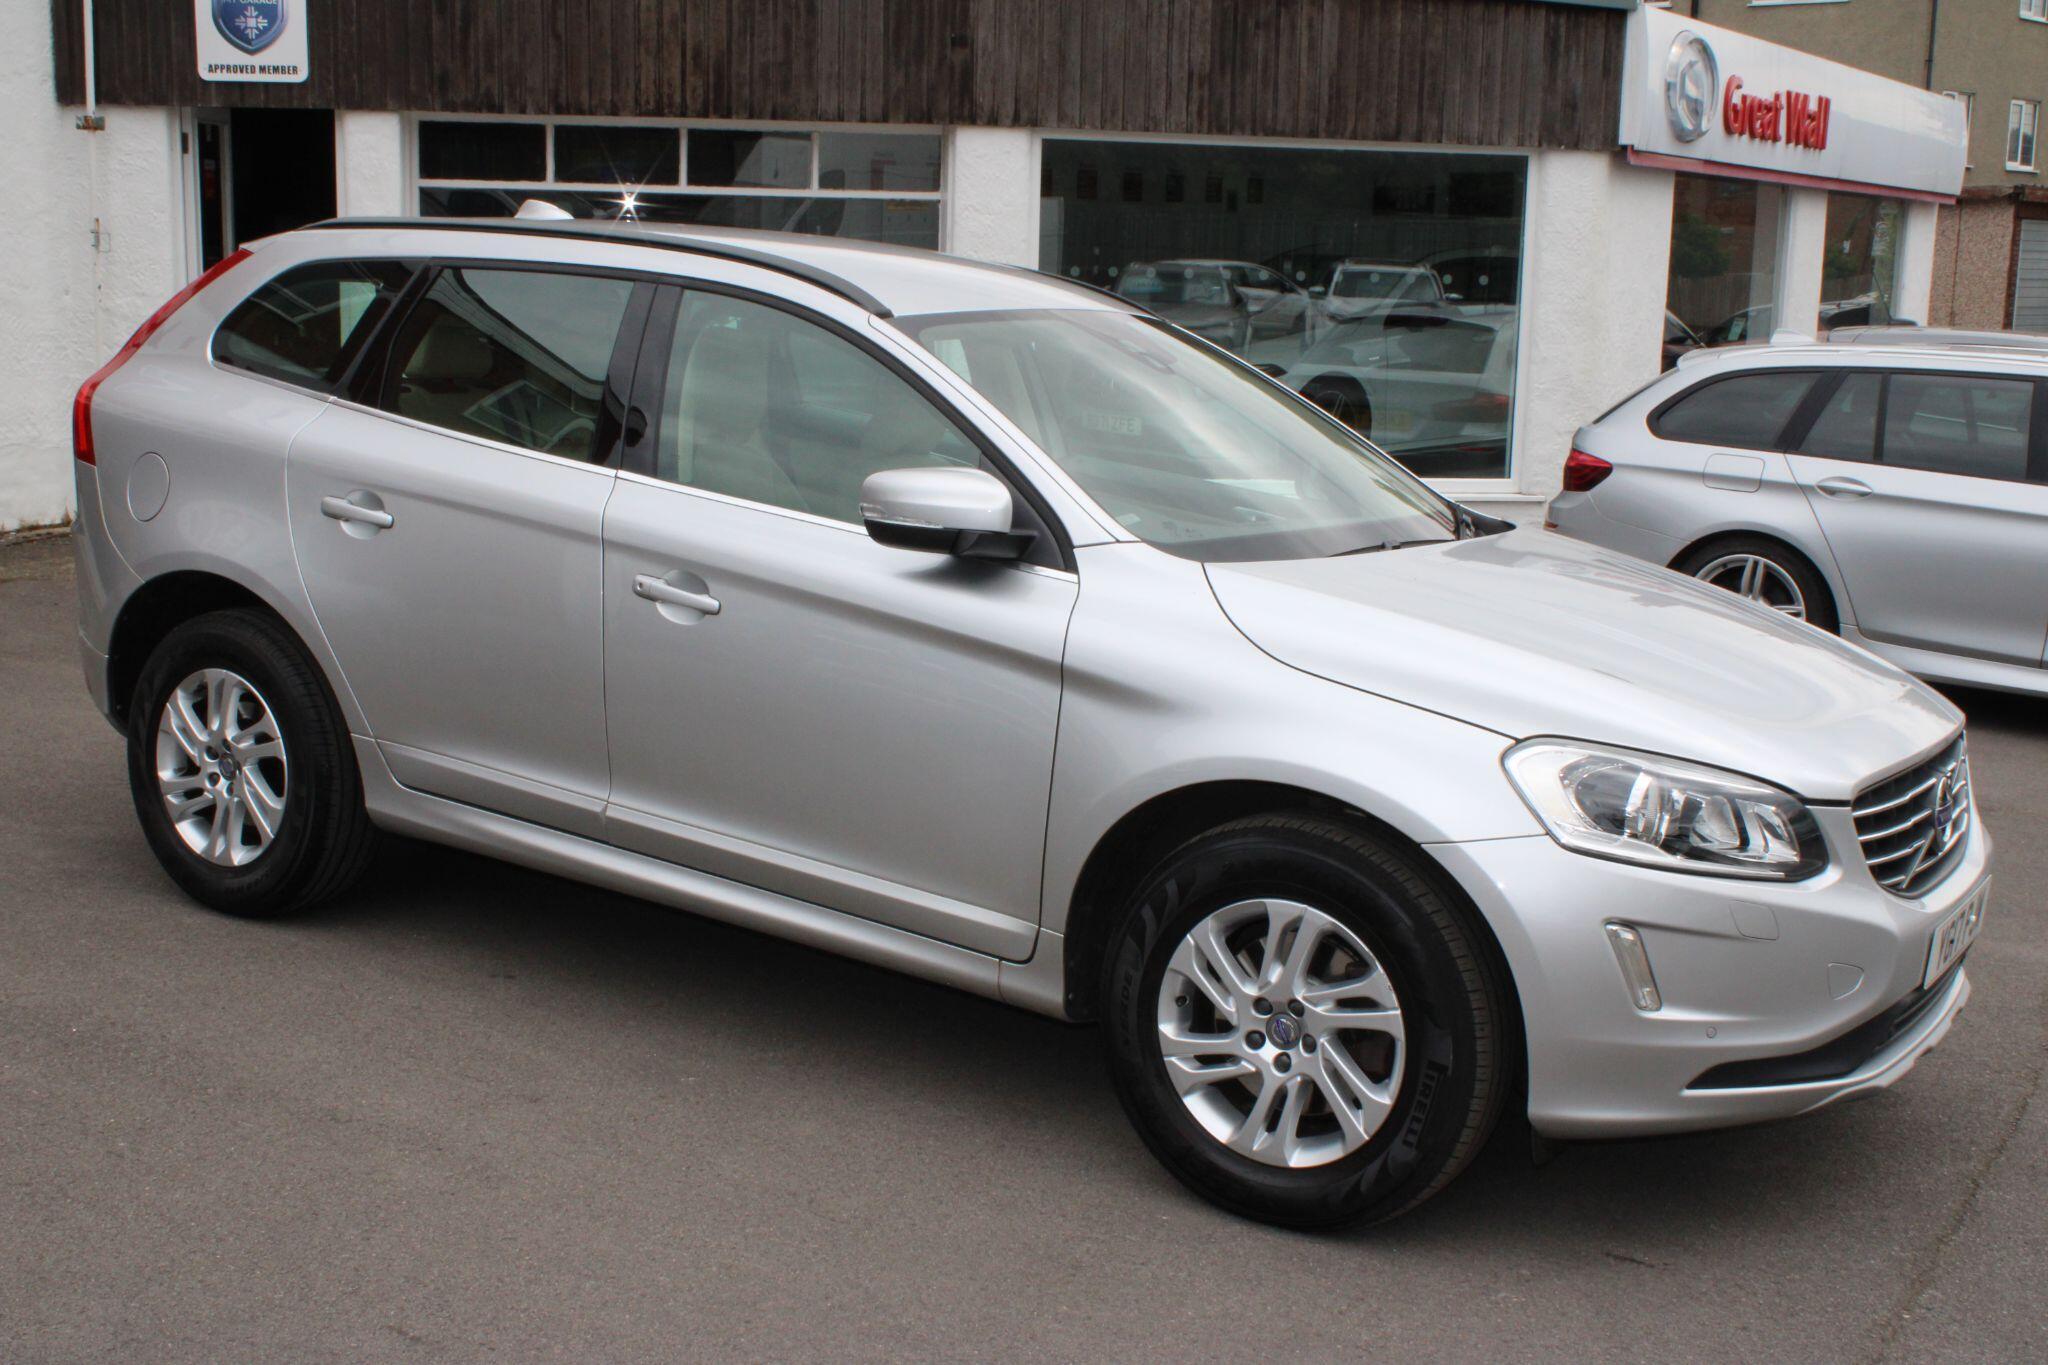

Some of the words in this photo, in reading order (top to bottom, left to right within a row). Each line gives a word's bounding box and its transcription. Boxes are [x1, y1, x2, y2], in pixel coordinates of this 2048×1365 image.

[208, 64, 256, 74] APPROVED
[259, 65, 298, 75] MEMBER
[1722, 74, 1784, 143] Great
[1785, 90, 1831, 151] Wall
[1402, 1059, 1450, 1149] PIRELLI
